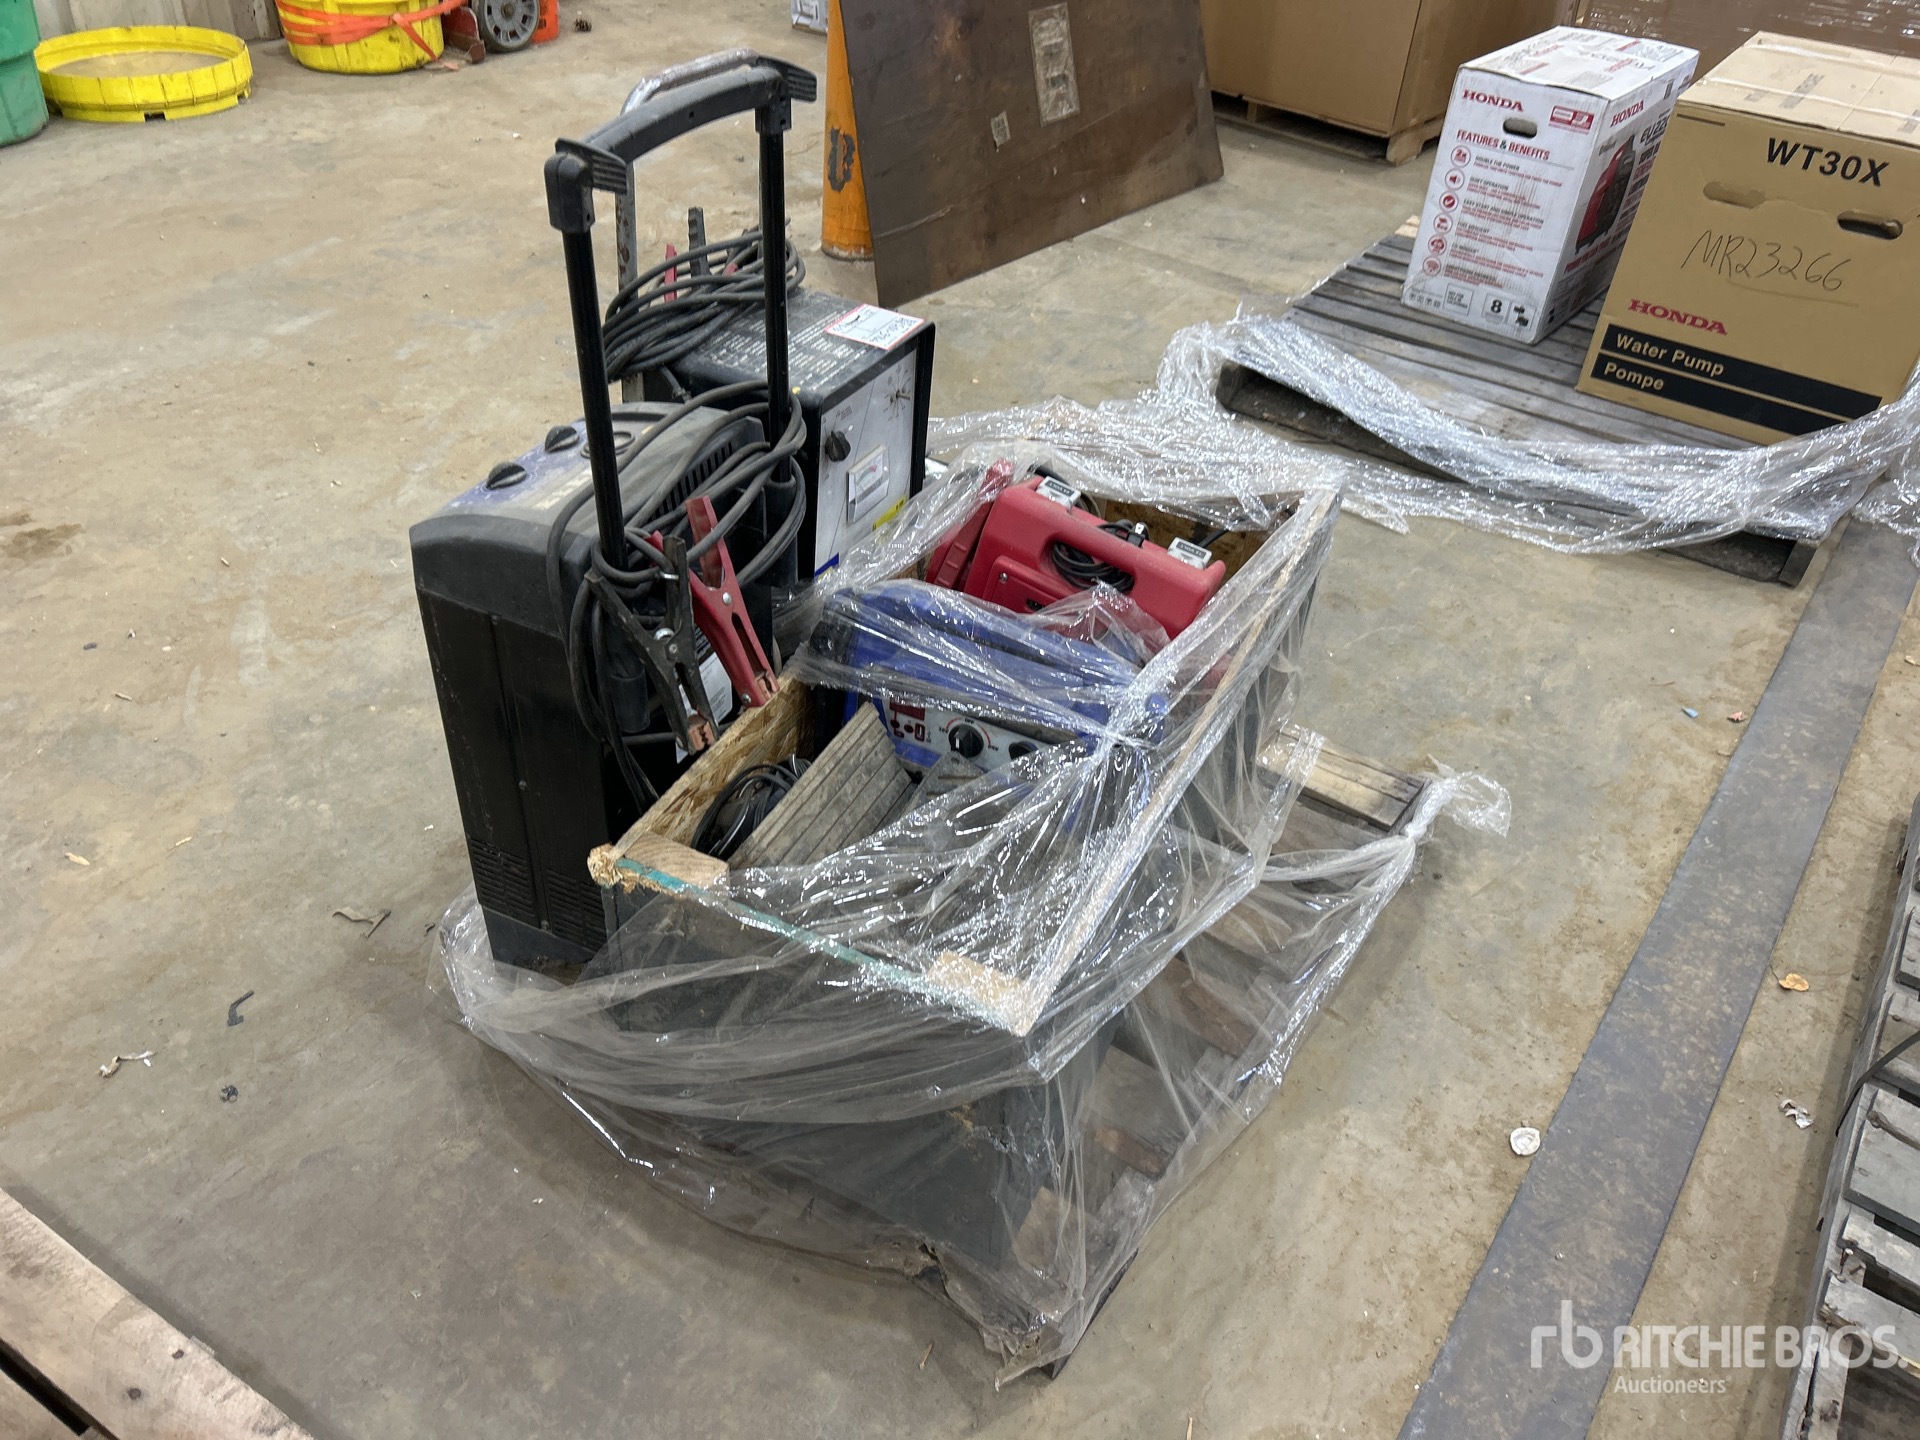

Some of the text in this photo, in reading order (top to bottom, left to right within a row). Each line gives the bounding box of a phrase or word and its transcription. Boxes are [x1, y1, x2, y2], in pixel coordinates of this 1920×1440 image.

[1462, 89, 1524, 113] HONDA
[1610, 100, 1644, 127] HONDA
[1456, 129, 1550, 161] FEATURES & BENEFITS
[1767, 137, 1889, 188] WT30X
[1680, 229, 1852, 291] MR23266
[1490, 299, 1503, 314] 8
[1628, 299, 1728, 336] HONDA
[1616, 333, 1724, 377] Water Pump
[1603, 362, 1664, 390] Pompe
